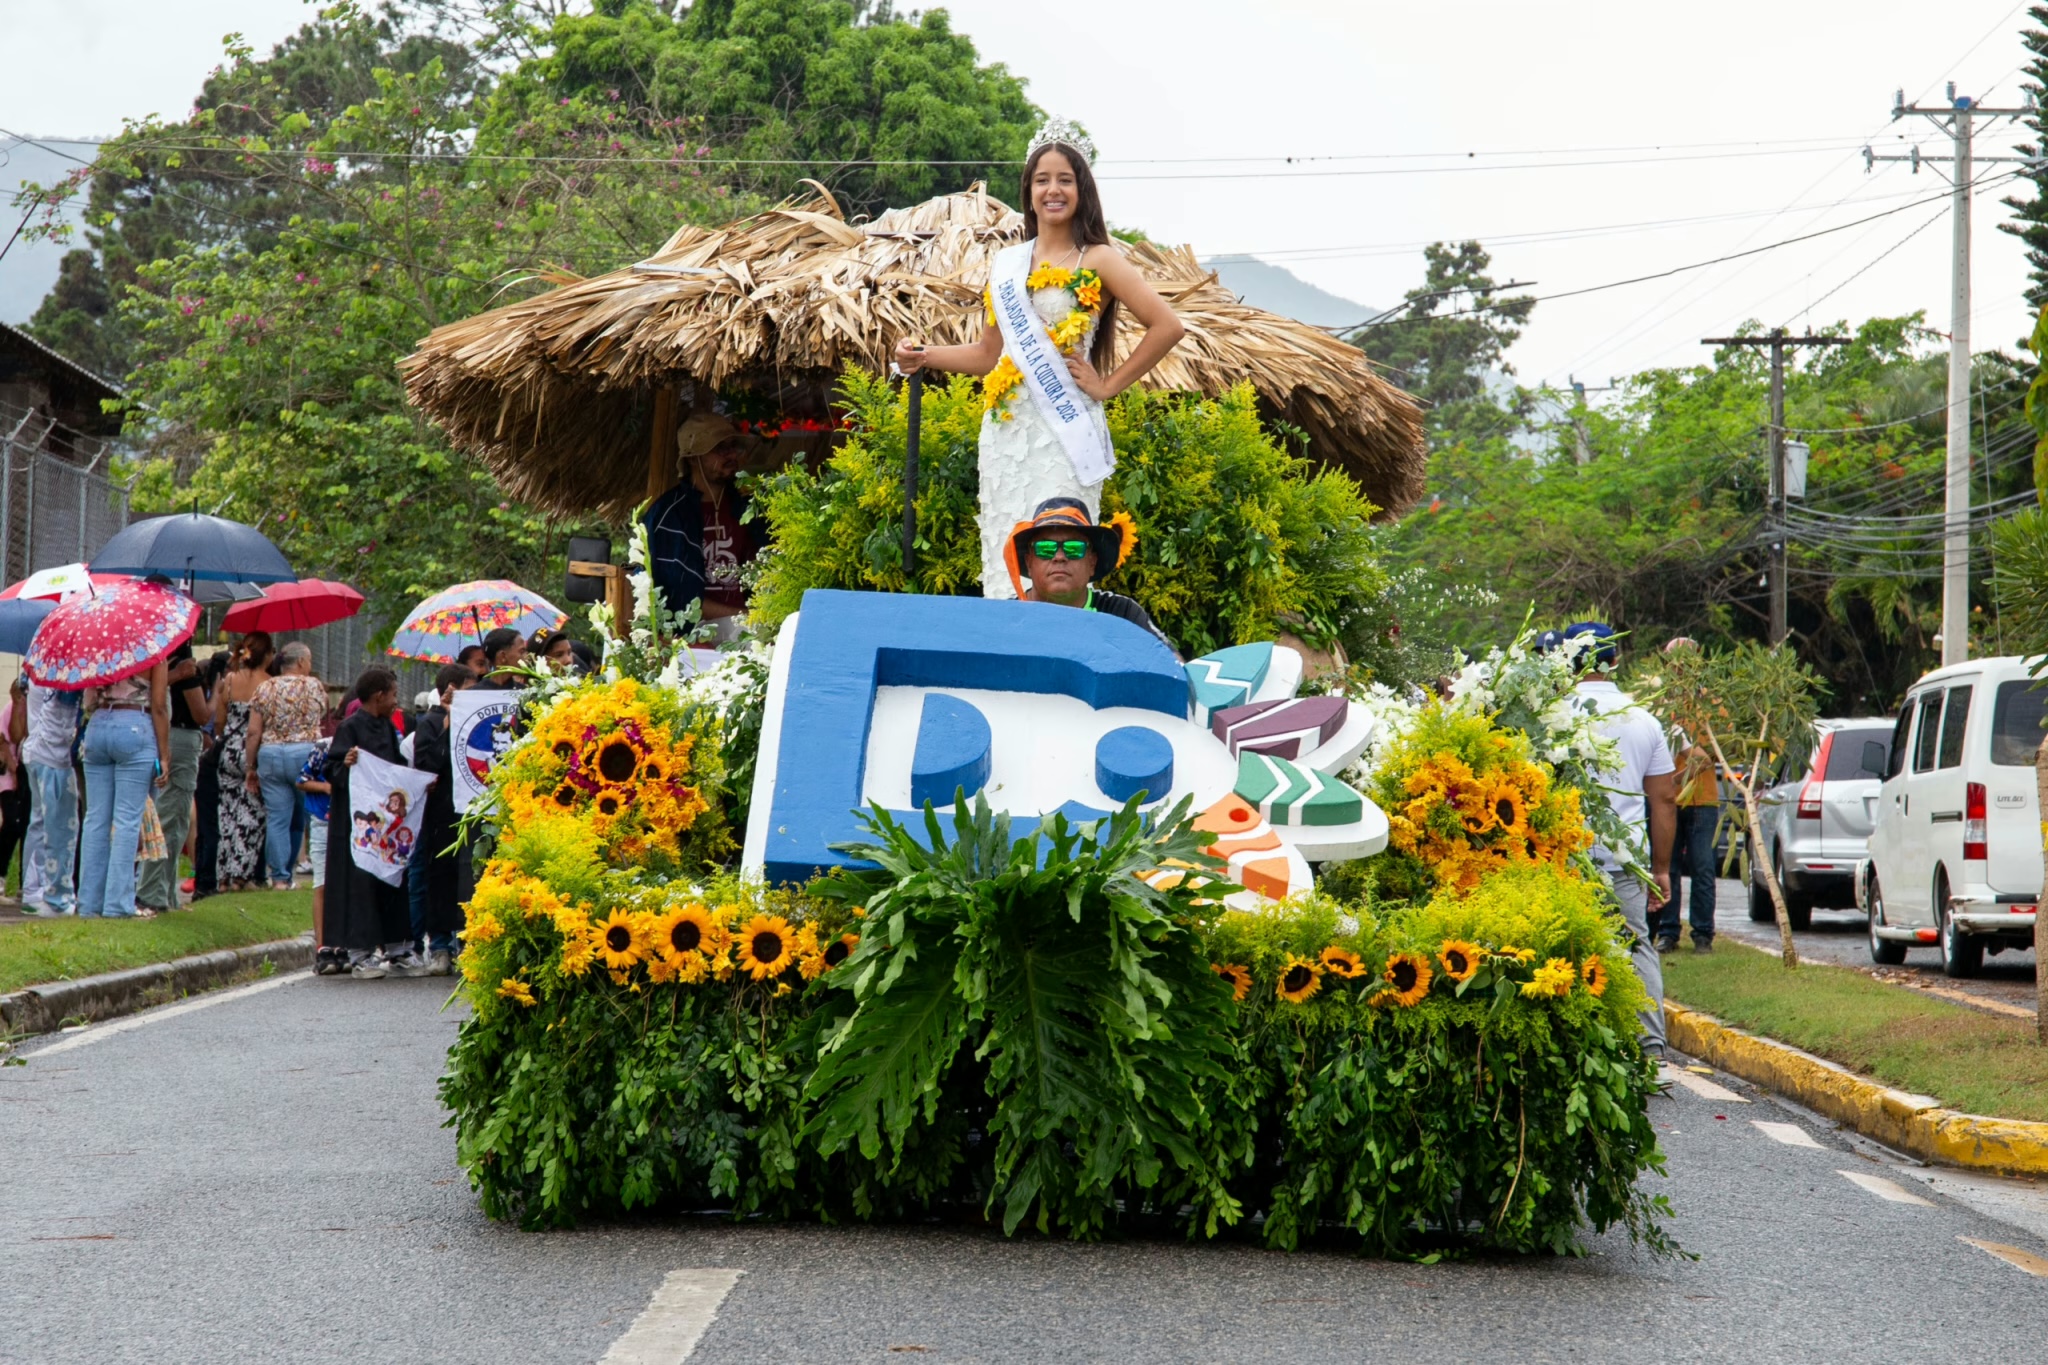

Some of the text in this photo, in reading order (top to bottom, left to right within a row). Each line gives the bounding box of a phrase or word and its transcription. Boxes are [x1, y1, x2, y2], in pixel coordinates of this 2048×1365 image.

[999, 278, 1079, 423] EMBAJADORA DE LA CULTURA 2026
[477, 706, 499, 720] DON
